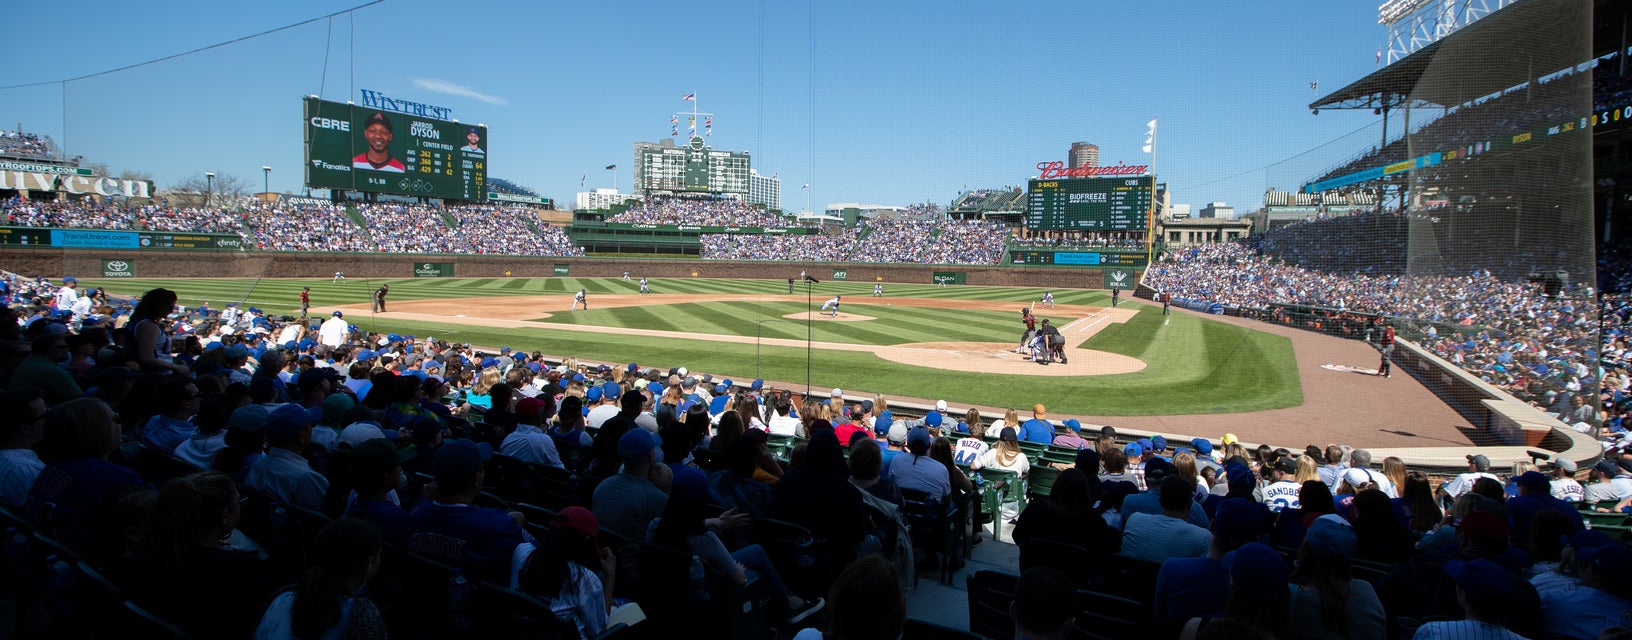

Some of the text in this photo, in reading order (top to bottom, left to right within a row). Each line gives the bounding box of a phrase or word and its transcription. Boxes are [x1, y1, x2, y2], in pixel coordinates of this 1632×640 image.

[311, 117, 350, 131] CBRE
[411, 121, 433, 130] JARROD
[1580, 117, 1587, 129] B
[1601, 111, 1609, 125] S
[410, 126, 440, 140] DYSON
[323, 162, 351, 172] Fanatics
[1036, 160, 1148, 179] Budweiser
[961, 440, 982, 449] RIZZO
[954, 450, 977, 464] 44
[1267, 487, 1300, 498] SANDBE
